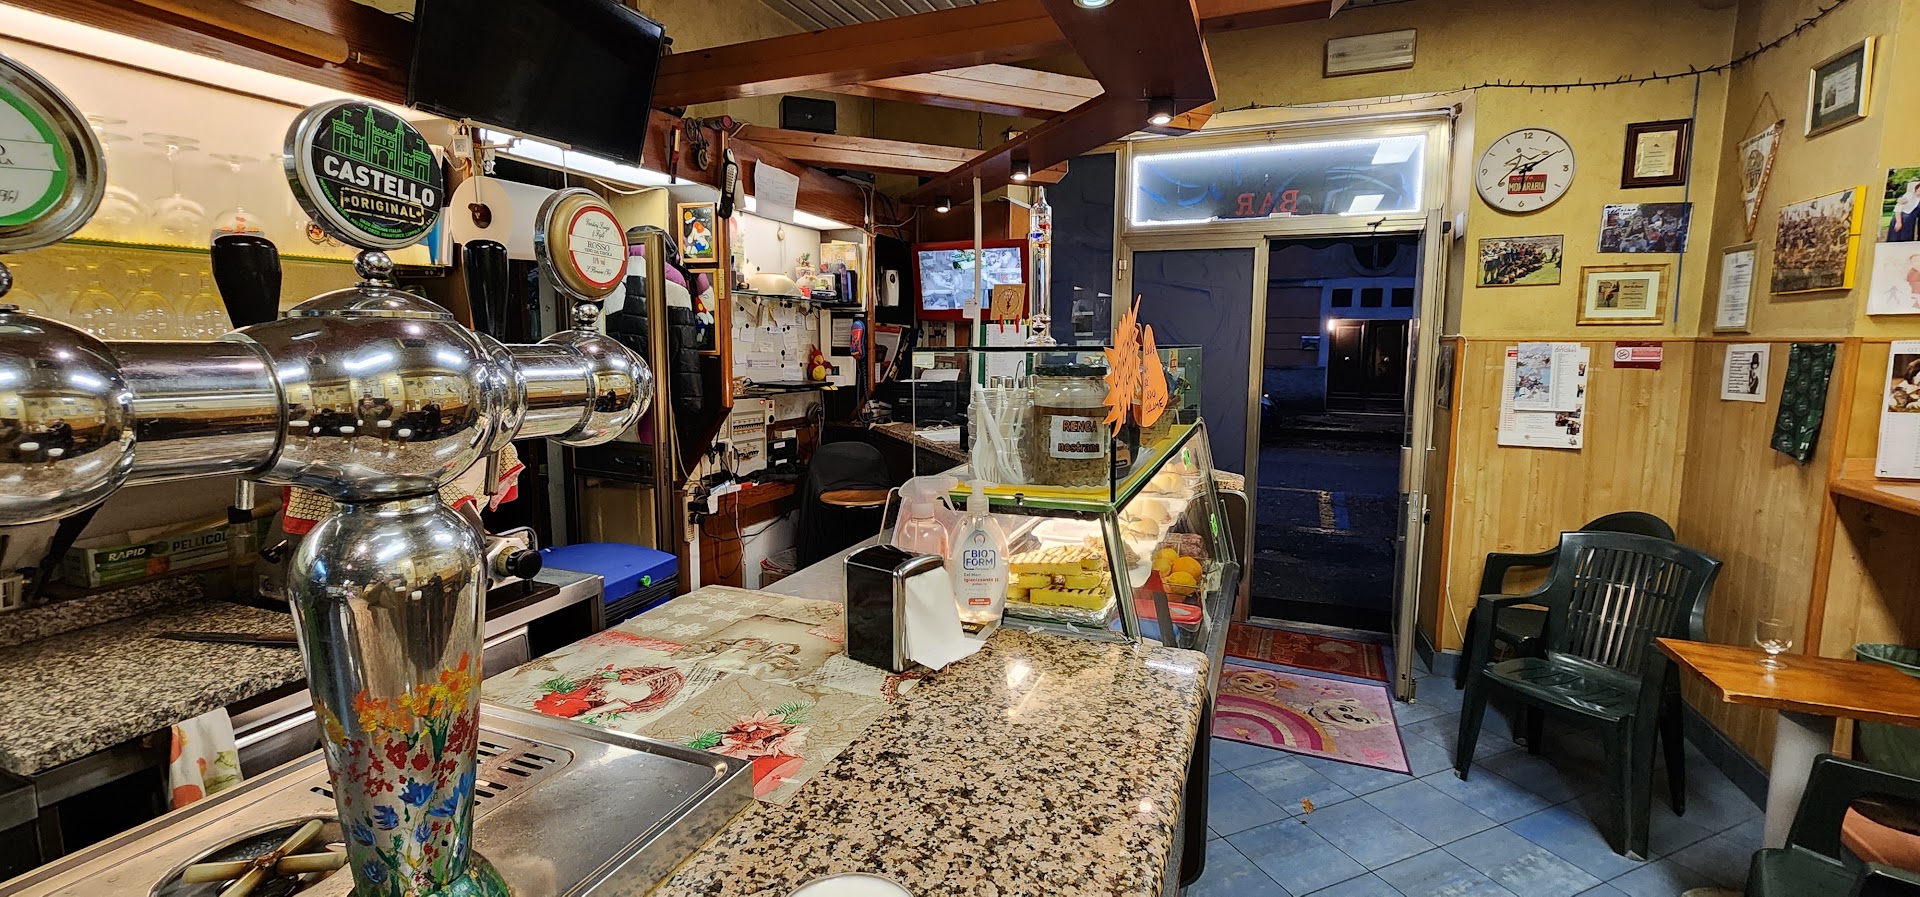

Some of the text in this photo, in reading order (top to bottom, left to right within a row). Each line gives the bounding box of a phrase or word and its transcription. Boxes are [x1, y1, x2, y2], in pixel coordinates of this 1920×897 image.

[1481, 168, 1488, 176] 9
[323, 155, 435, 207] CASTELLO
[350, 195, 417, 219] ORIGINAL
[1518, 200, 1525, 208] 6
[587, 240, 610, 252] ROSSO
[1057, 441, 1100, 453] nostrana
[172, 532, 227, 551] PELLICOL
[108, 547, 146, 562] RAPID
[971, 549, 988, 558] BIO
[965, 558, 993, 566] FORM
